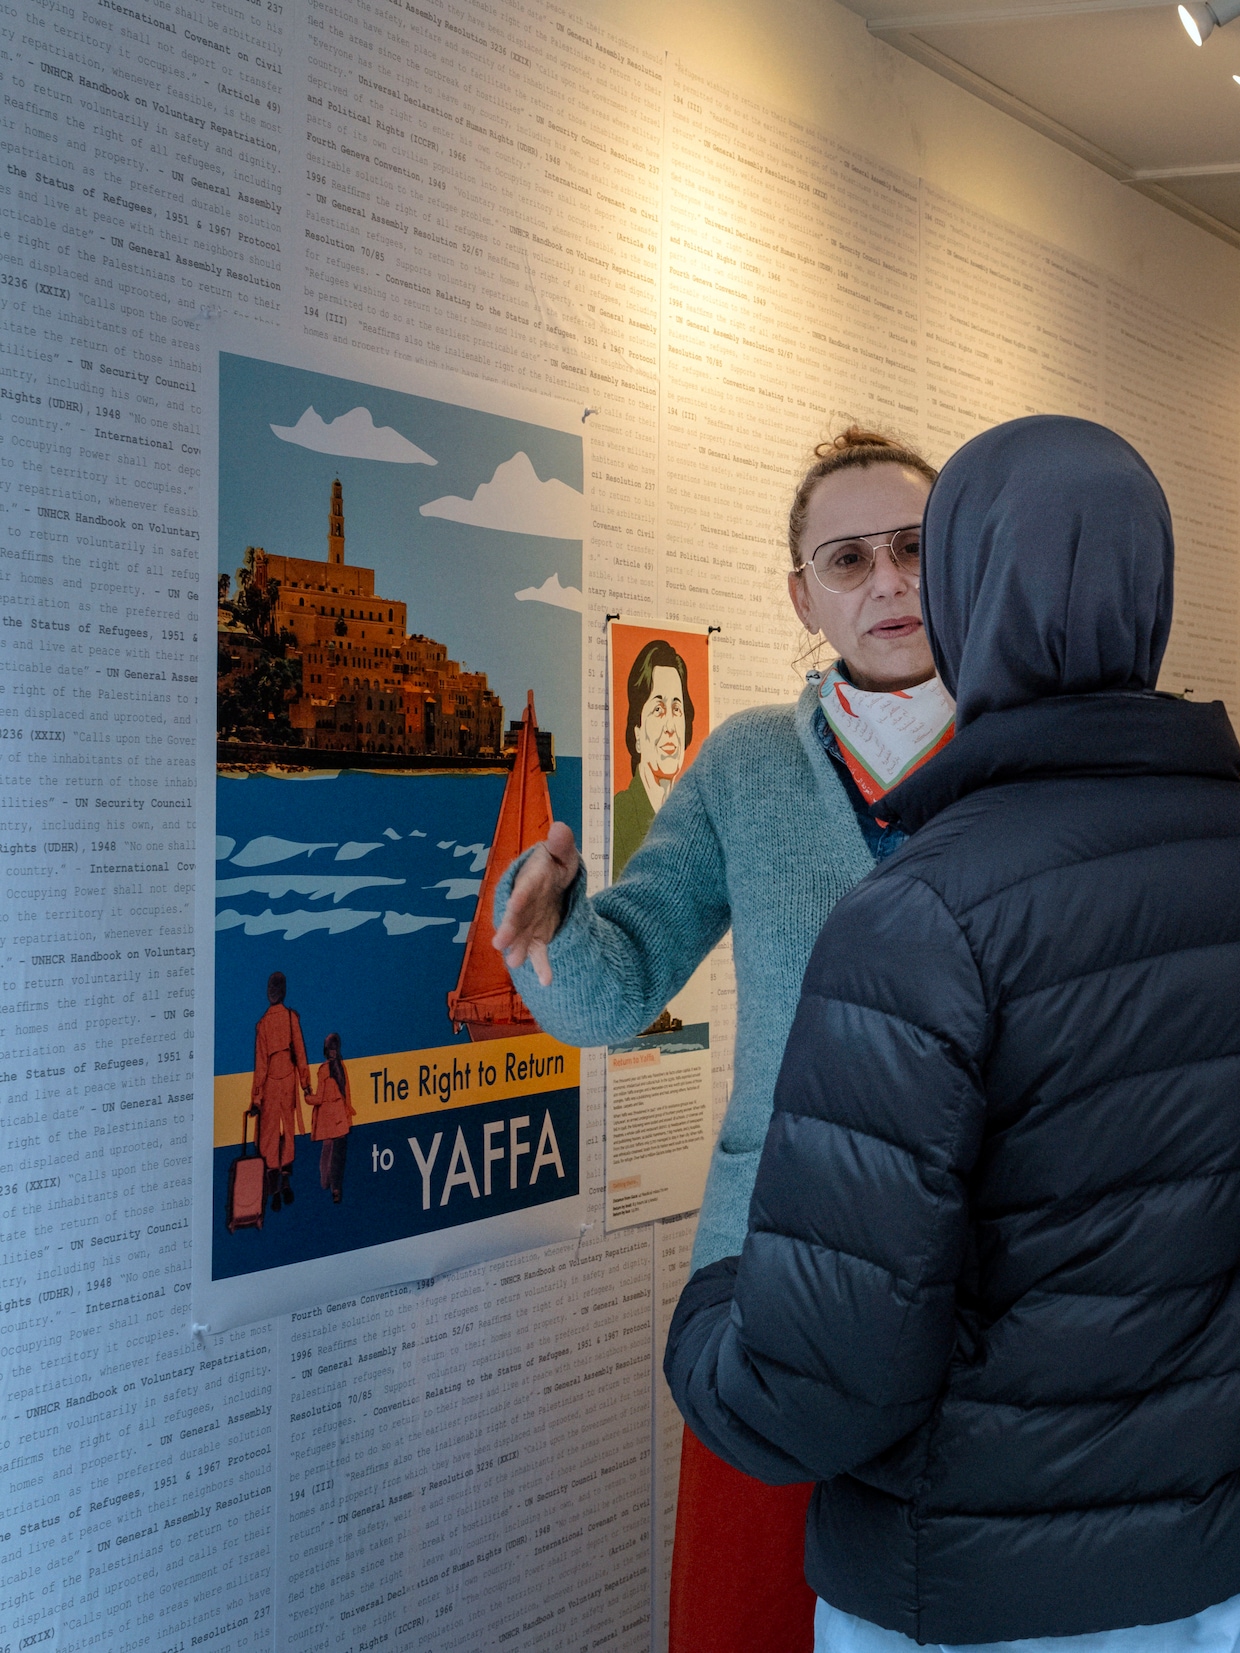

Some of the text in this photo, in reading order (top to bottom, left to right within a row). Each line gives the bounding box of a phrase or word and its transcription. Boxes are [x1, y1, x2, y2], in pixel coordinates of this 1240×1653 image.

[184, 29, 231, 55] Covenant
[237, 51, 249, 62] on
[255, 57, 283, 75] Civil
[40, 61, 281, 155] UNHCR Handbook on Voluntary Repatriation,
[307, 94, 323, 107] and
[327, 100, 372, 126] Political
[376, 119, 405, 138] Rights
[449, 148, 467, 163] 1966
[3, 94, 282, 196] Reaffirms the right of all refugees, including
[24, 123, 282, 216] homes and property. UN General Assembly
[306, 131, 446, 191] Fourth Geneva Convention, 1949
[536, 114, 660, 175] UN Security Council Resolution 237
[6, 164, 281, 253] the Status of Refugees, 1951 & 1967 Protocol
[110, 236, 124, 248] UN
[128, 241, 171, 262] General
[175, 254, 223, 278] Assembly
[226, 268, 282, 291] Resolution
[304, 228, 385, 262] Resolution 70/85
[0, 273, 28, 290] 3236
[35, 282, 71, 301] (XXIX)
[120, 305, 145, 318] upon
[149, 311, 167, 323] the
[385, 273, 432, 295] Convention
[436, 289, 471, 310] Relating
[475, 302, 485, 312] to
[489, 306, 501, 317] the
[505, 311, 529, 326] Status
[533, 321, 542, 330] of
[583, 335, 598, 348] 1951
[610, 343, 625, 355] 1967
[628, 350, 656, 365] Protocol
[304, 305, 319, 318] 194
[325, 311, 348, 327] (III)
[404, 334, 423, 347] also
[427, 340, 440, 352] the
[0, 388, 42, 405] Rights
[96, 406, 121, 420] 1948
[722, 376, 784, 403] Convention Relating
[37, 506, 144, 531] UNHCR Handbook on
[2, 616, 185, 642] the Status of Refugees, 1951
[13, 639, 184, 661] and live at peace with their
[75, 798, 192, 811] UN Security Council
[370, 1052, 565, 1104] The Right to Return
[613, 1056, 632, 1067] Return
[371, 1144, 395, 1173] to
[407, 1108, 566, 1211] YAFFA
[25, 1346, 271, 1420] UNHCR Handbook on Voluntary Repatriation,
[289, 1389, 373, 1423] Resolution 70/85
[19, 1443, 272, 1536] Status of Refugees, 1951 & 1967 Protocol
[289, 1478, 335, 1503] 194 (III)
[191, 1604, 271, 1647] Resolution 237
